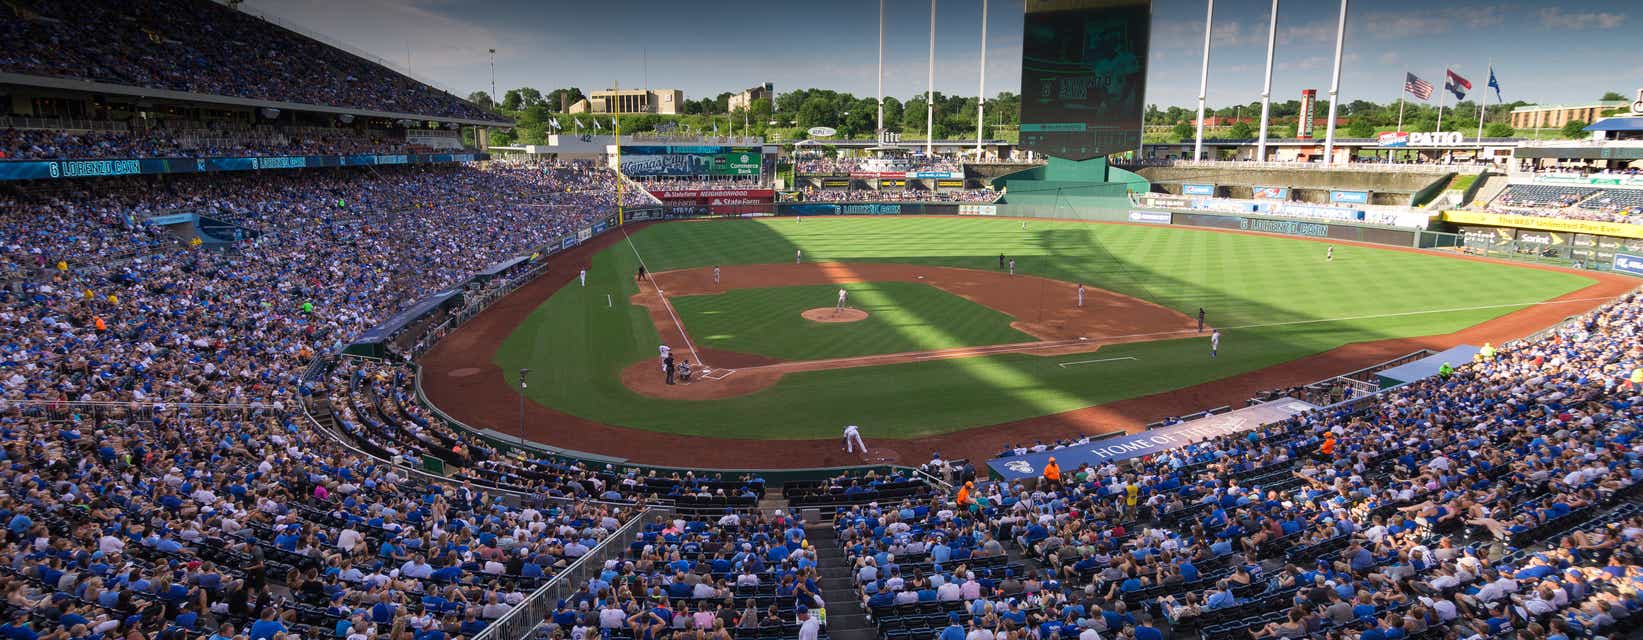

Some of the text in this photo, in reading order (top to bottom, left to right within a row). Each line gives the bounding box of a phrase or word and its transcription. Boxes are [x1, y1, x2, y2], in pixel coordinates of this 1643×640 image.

[581, 134, 592, 143] 42
[1409, 131, 1463, 146] PATIO
[49, 160, 140, 178] 6 LORENZO CAIN
[1458, 229, 1496, 245] Sprint
[1521, 233, 1550, 244] Sprint
[1092, 439, 1154, 458] HOME
[1151, 433, 1178, 445] OF
